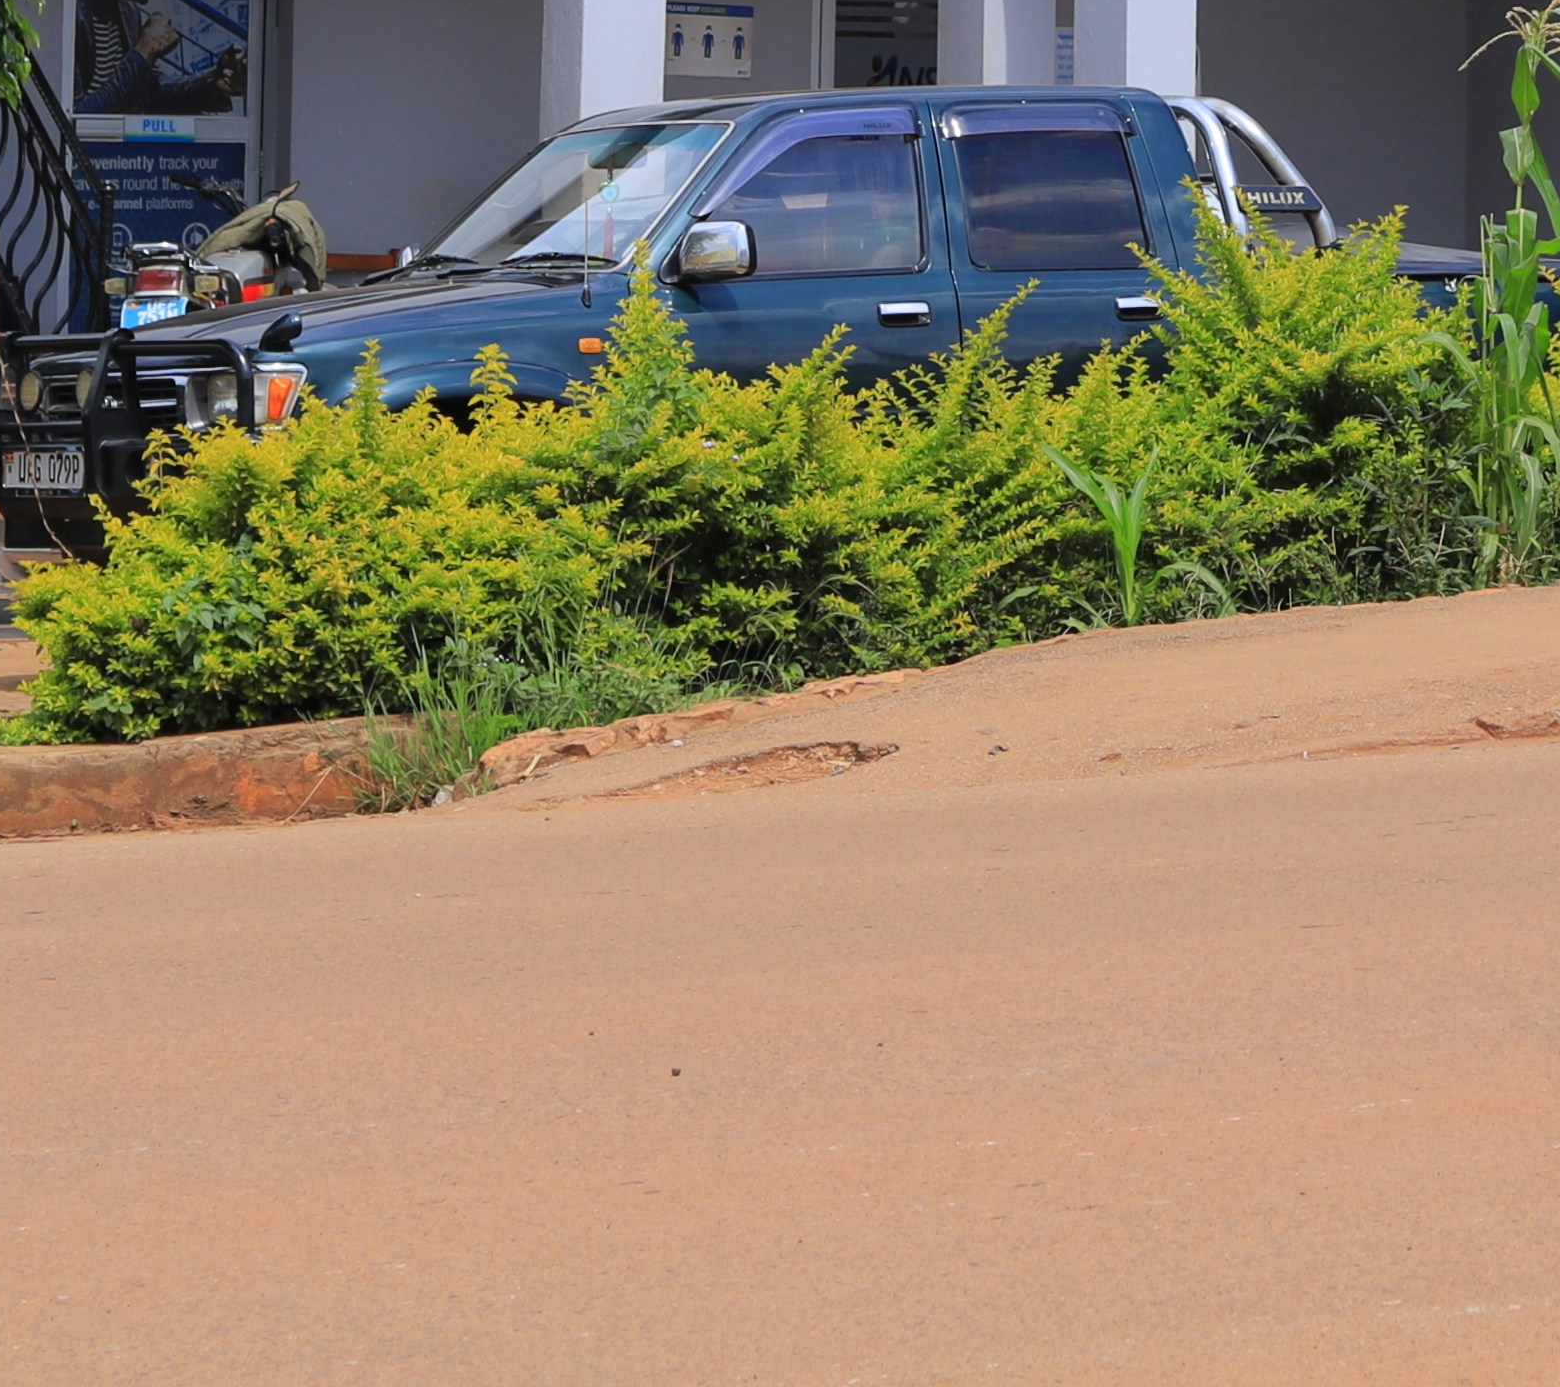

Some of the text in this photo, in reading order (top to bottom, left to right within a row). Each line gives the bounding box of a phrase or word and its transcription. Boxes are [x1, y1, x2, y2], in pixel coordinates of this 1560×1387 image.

[142, 119, 177, 133] PULL
[159, 156, 190, 170] track
[192, 158, 220, 172] your
[122, 176, 158, 191] round
[145, 197, 194, 212] platforms
[1246, 191, 1306, 205] HILUX
[48, 454, 80, 484] 079P
